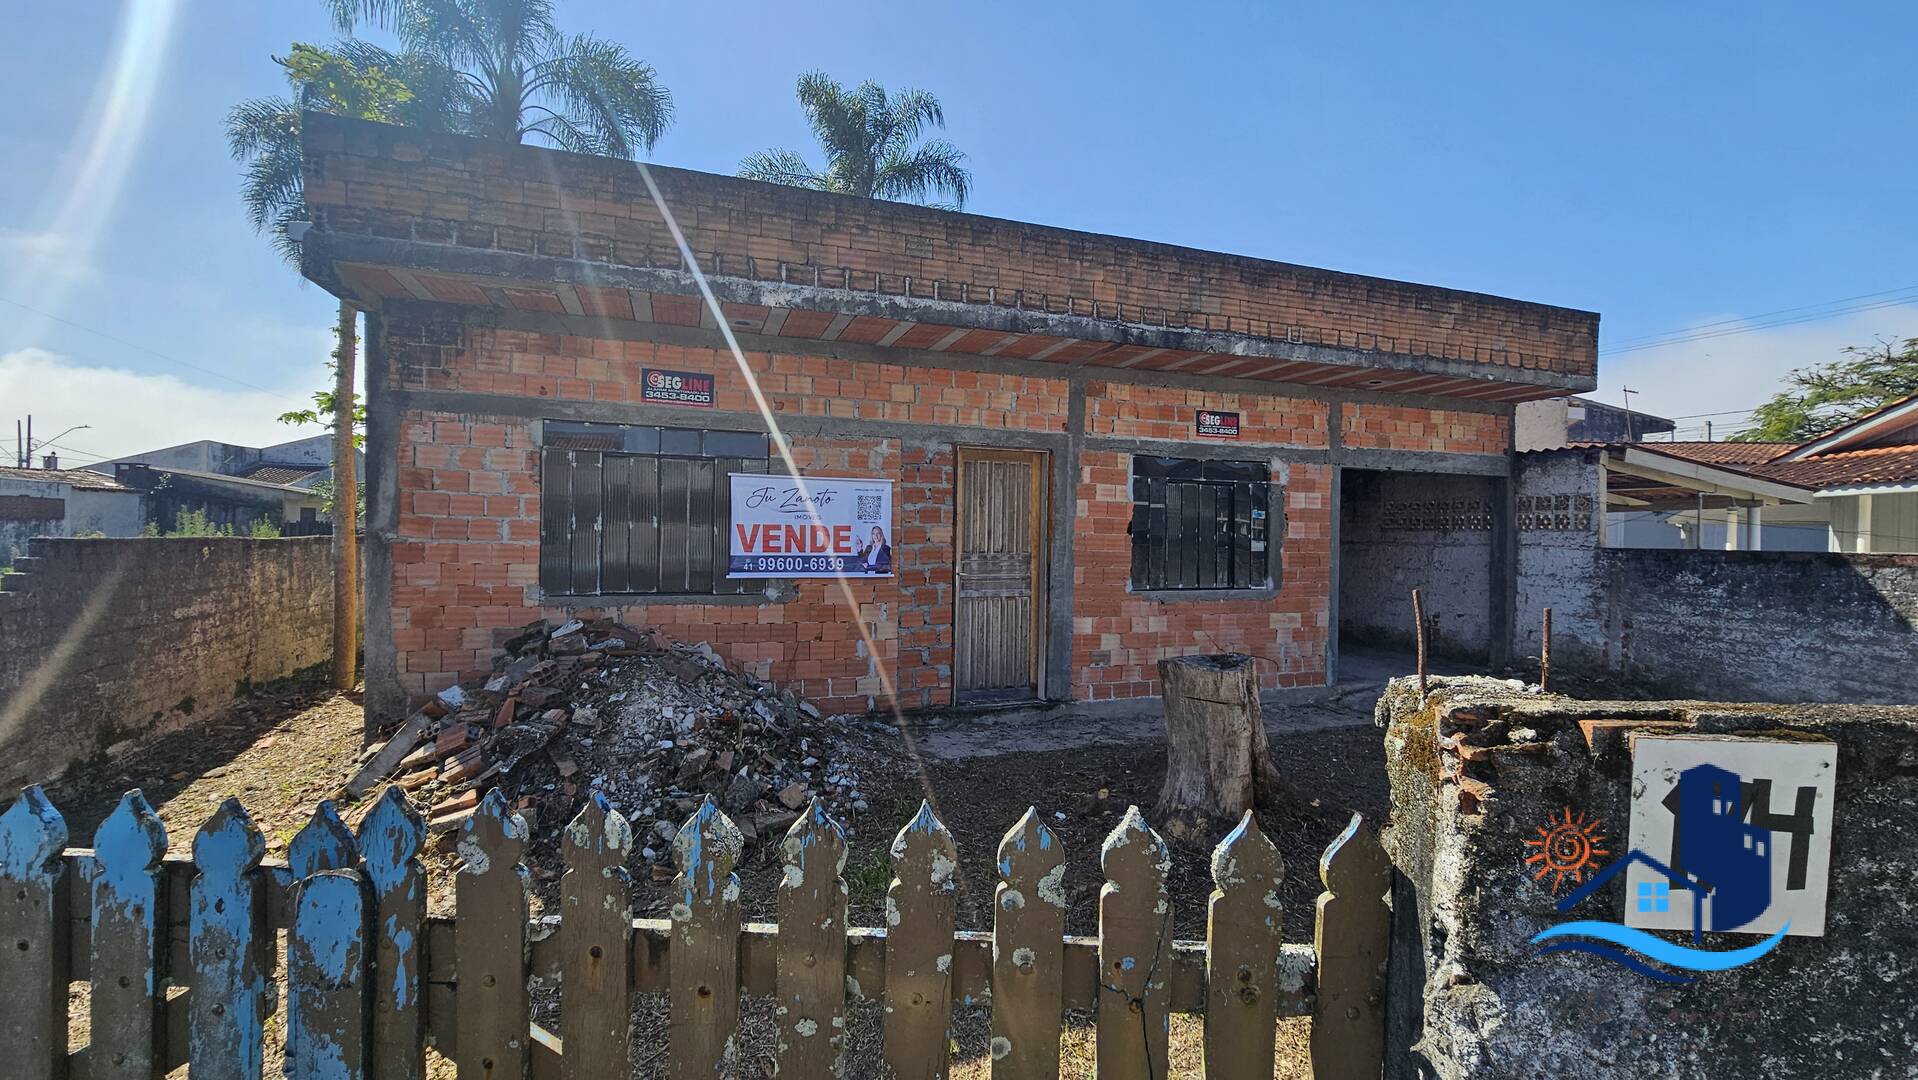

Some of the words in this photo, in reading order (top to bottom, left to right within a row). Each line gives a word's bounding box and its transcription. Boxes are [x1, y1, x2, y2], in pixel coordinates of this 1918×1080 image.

[646, 391, 710, 402] 3453-8400
[746, 487, 776, 508] Ju
[779, 488, 838, 508] Zanoto
[736, 524, 851, 553] VENDE
[743, 563, 753, 571] 41
[758, 557, 844, 571] 99600-6939
